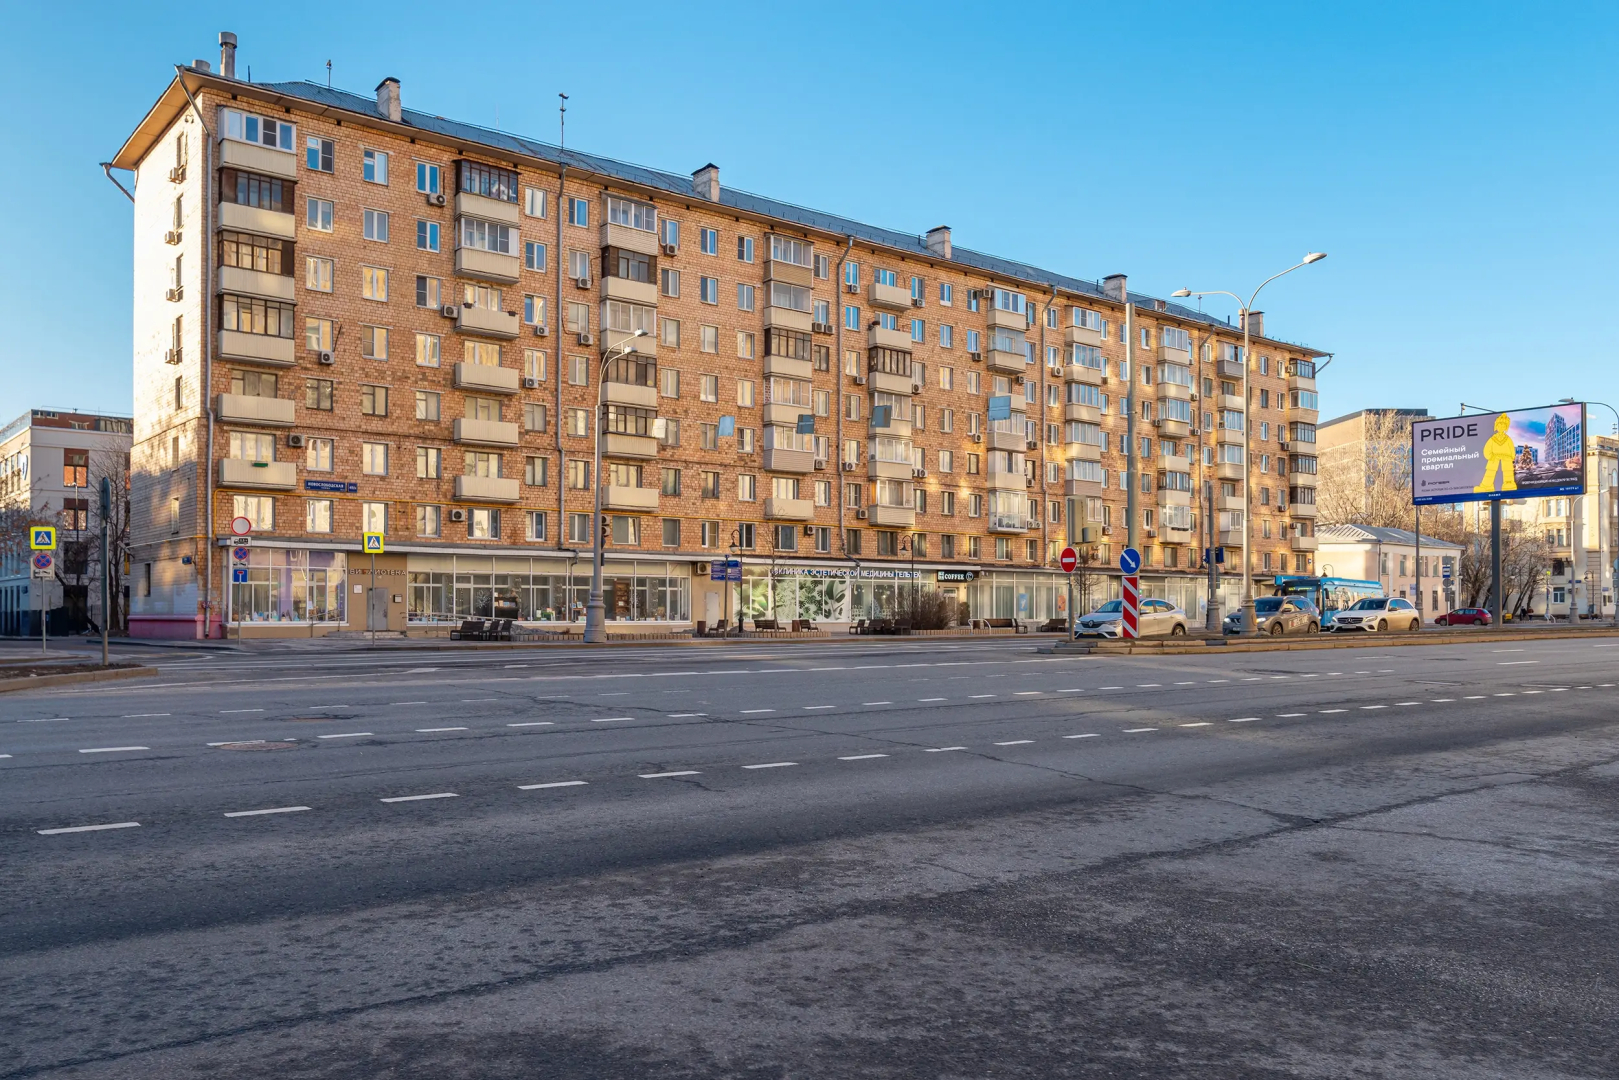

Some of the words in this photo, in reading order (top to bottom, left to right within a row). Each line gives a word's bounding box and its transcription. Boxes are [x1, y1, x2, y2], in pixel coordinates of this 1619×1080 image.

[1421, 424, 1478, 442] PRIDE
[1421, 445, 1466, 456] Семейный
[1421, 452, 1479, 464] премиальный
[1421, 463, 1454, 471] квартал
[811, 569, 858, 577] ЭСТЕТИЧЕСКОЙ
[860, 570, 894, 578] МЕДИЦИНЫ
